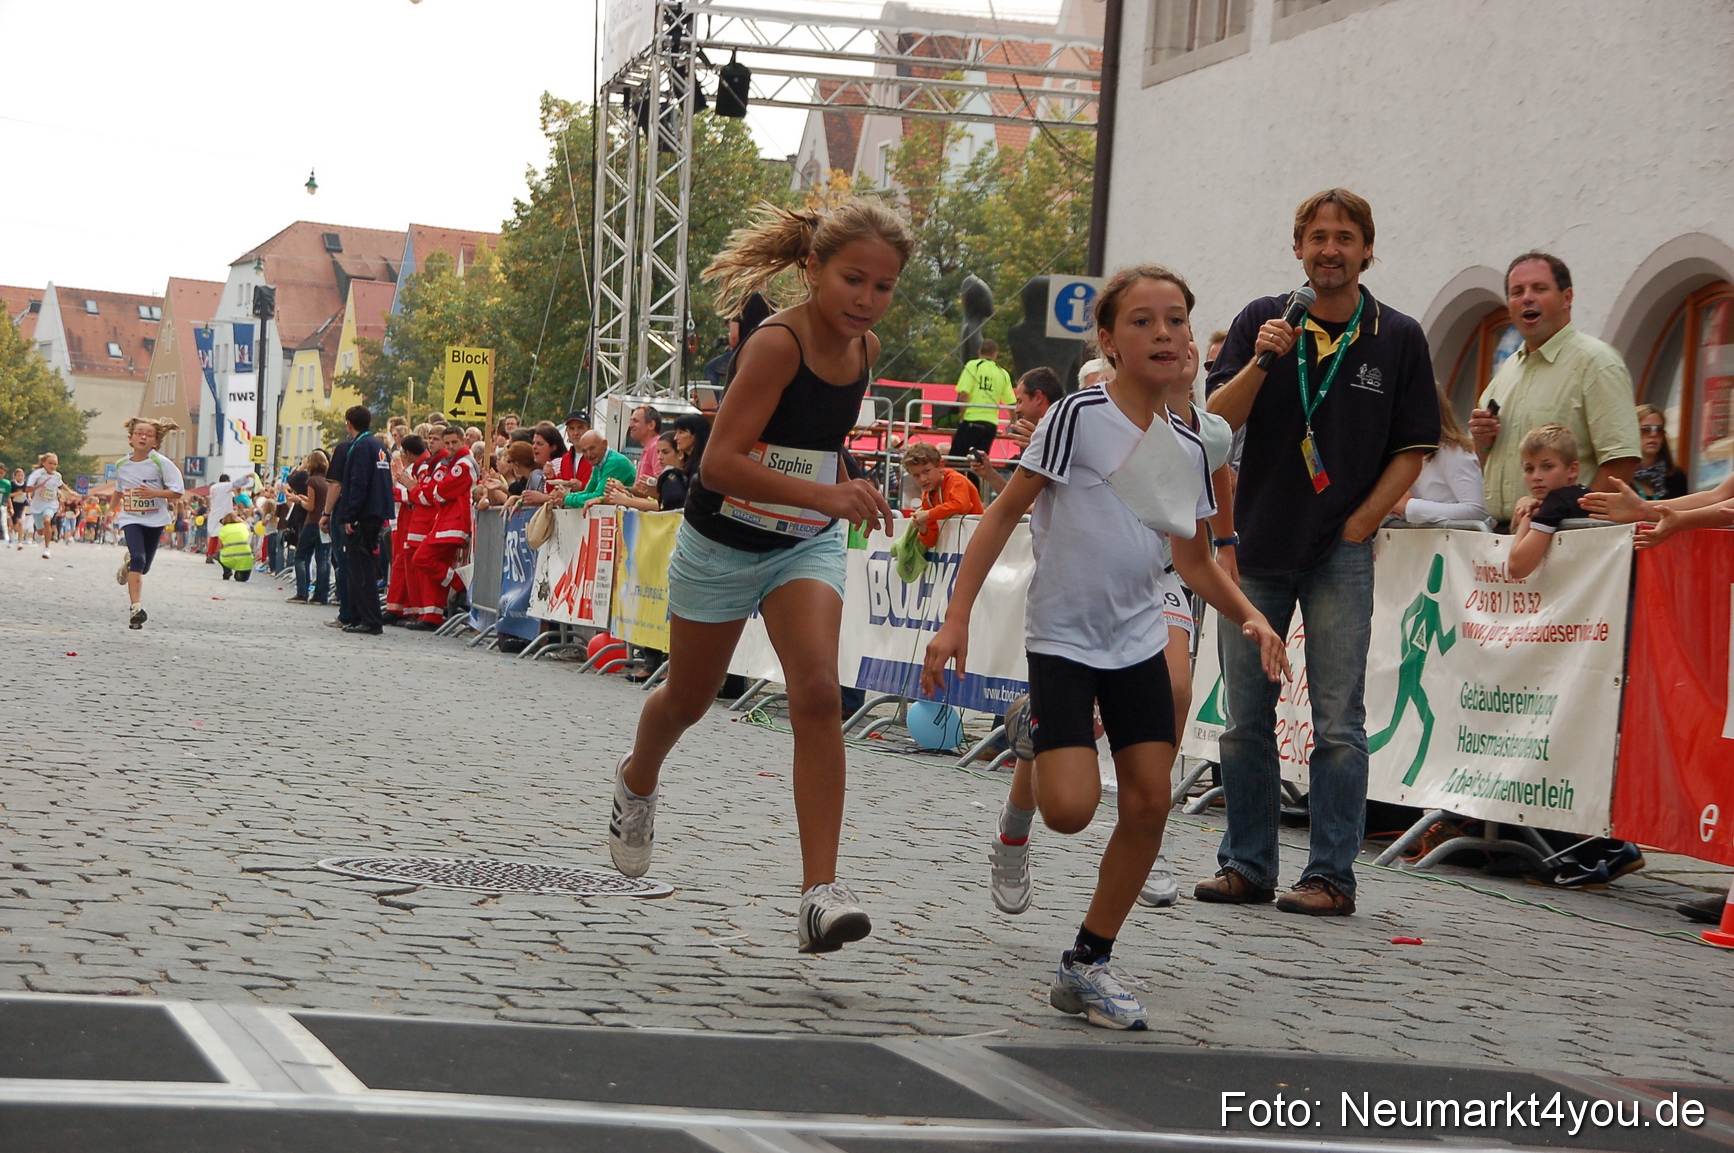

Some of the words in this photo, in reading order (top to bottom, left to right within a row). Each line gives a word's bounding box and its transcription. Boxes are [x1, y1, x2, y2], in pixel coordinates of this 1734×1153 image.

[451, 350, 489, 365] Block
[454, 370, 483, 406] A
[254, 444, 264, 458] B
[768, 452, 813, 475] Sophie
[132, 499, 156, 508] 7091
[1460, 682, 1558, 725] Gebäudereinigung
[1456, 725, 1550, 762] Hausmeisterdienst
